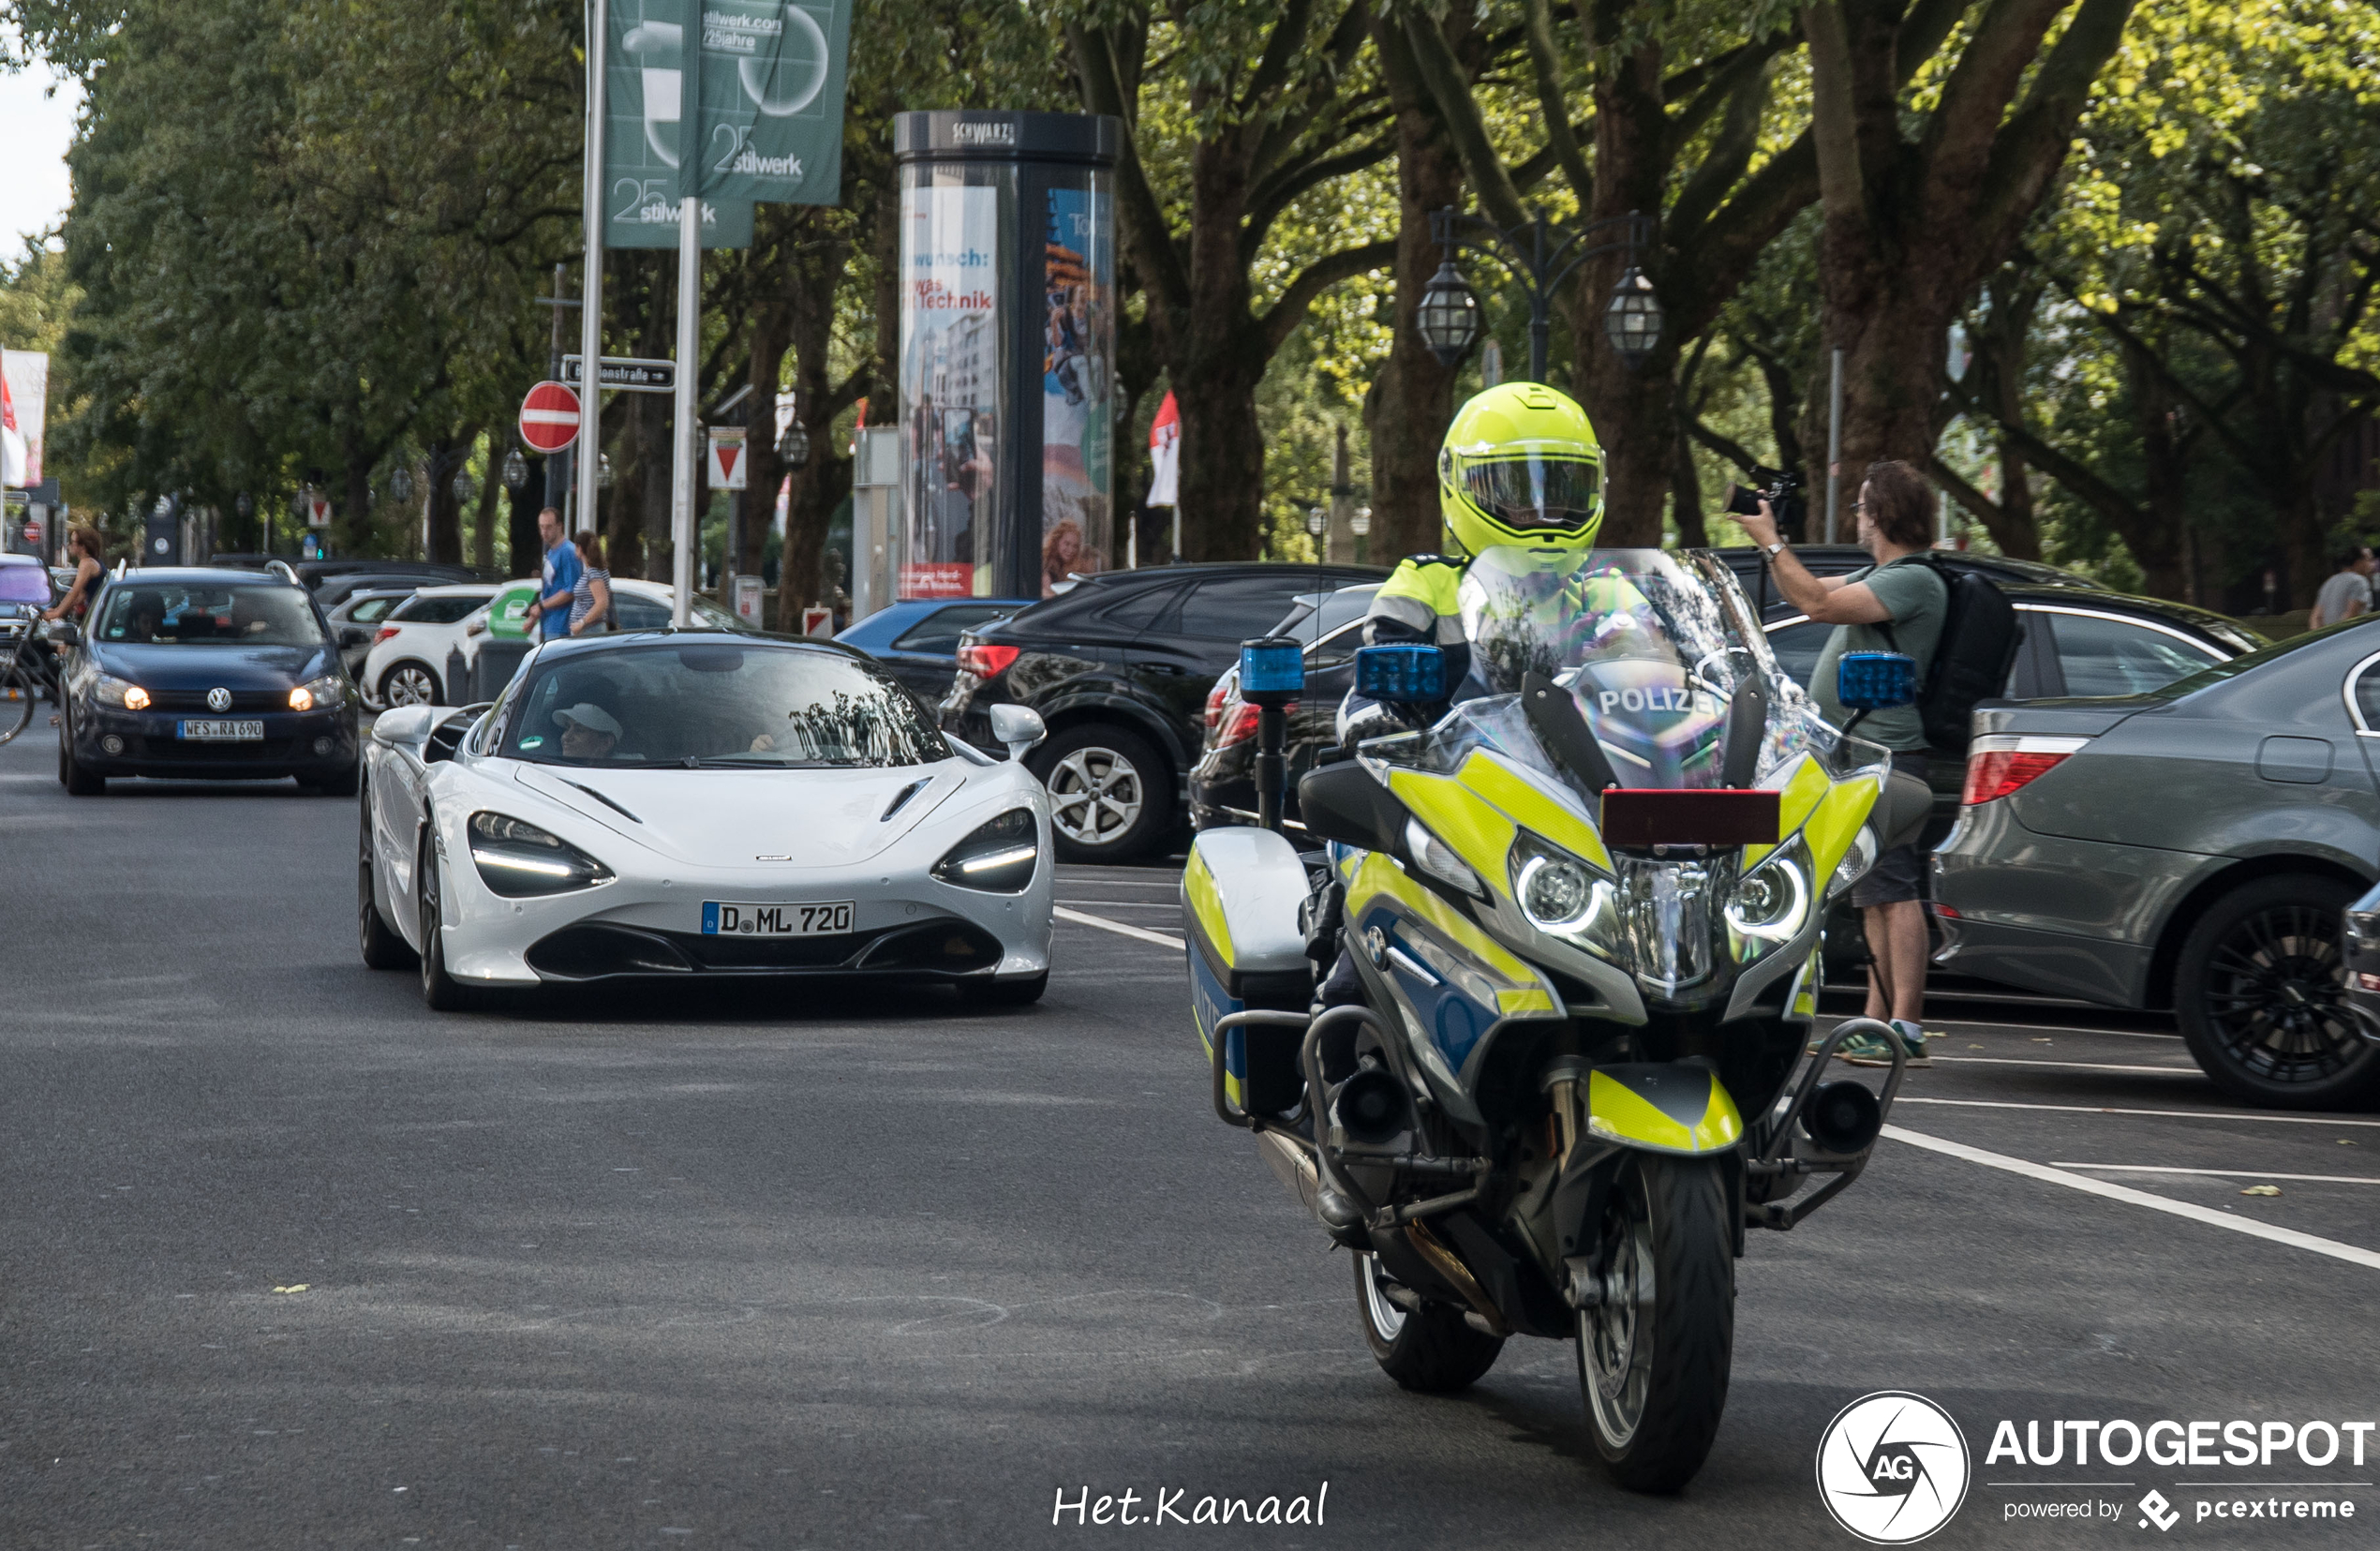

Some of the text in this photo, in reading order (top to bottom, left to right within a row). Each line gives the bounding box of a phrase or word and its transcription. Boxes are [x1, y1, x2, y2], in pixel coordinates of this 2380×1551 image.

[703, 28, 756, 47] /25jahre
[952, 122, 1009, 144] SCHWARZ
[713, 123, 803, 175] 25 stilwerk
[613, 177, 716, 224] 25 stilwk
[917, 290, 992, 310] Technik
[574, 364, 649, 381] Bionstraße
[186, 721, 262, 736] WES RA 690
[721, 906, 739, 932] D
[756, 907, 793, 932] ML
[799, 905, 850, 932] 720
